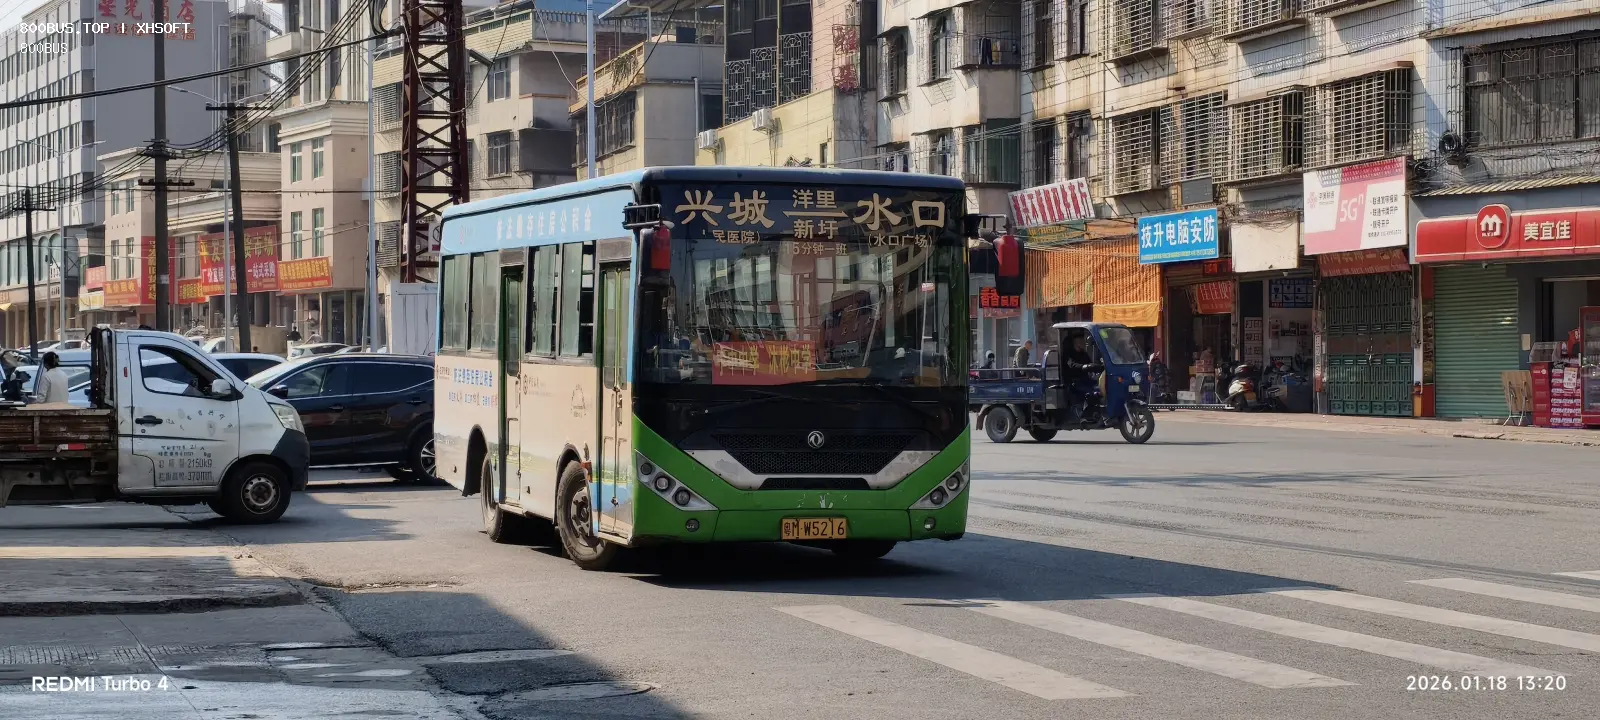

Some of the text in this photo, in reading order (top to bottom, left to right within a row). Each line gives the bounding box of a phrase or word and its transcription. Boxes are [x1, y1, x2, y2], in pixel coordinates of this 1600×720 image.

[98, 0, 195, 23] 星光店
[675, 189, 775, 228] 兴城
[792, 189, 838, 209] 洋里
[853, 193, 946, 230] 水口
[793, 219, 839, 240] 新圩
[1141, 215, 1215, 248] 技升电脑安防
[1524, 220, 1571, 240] 美宜佳
[785, 242, 848, 256] 15分钟一班
